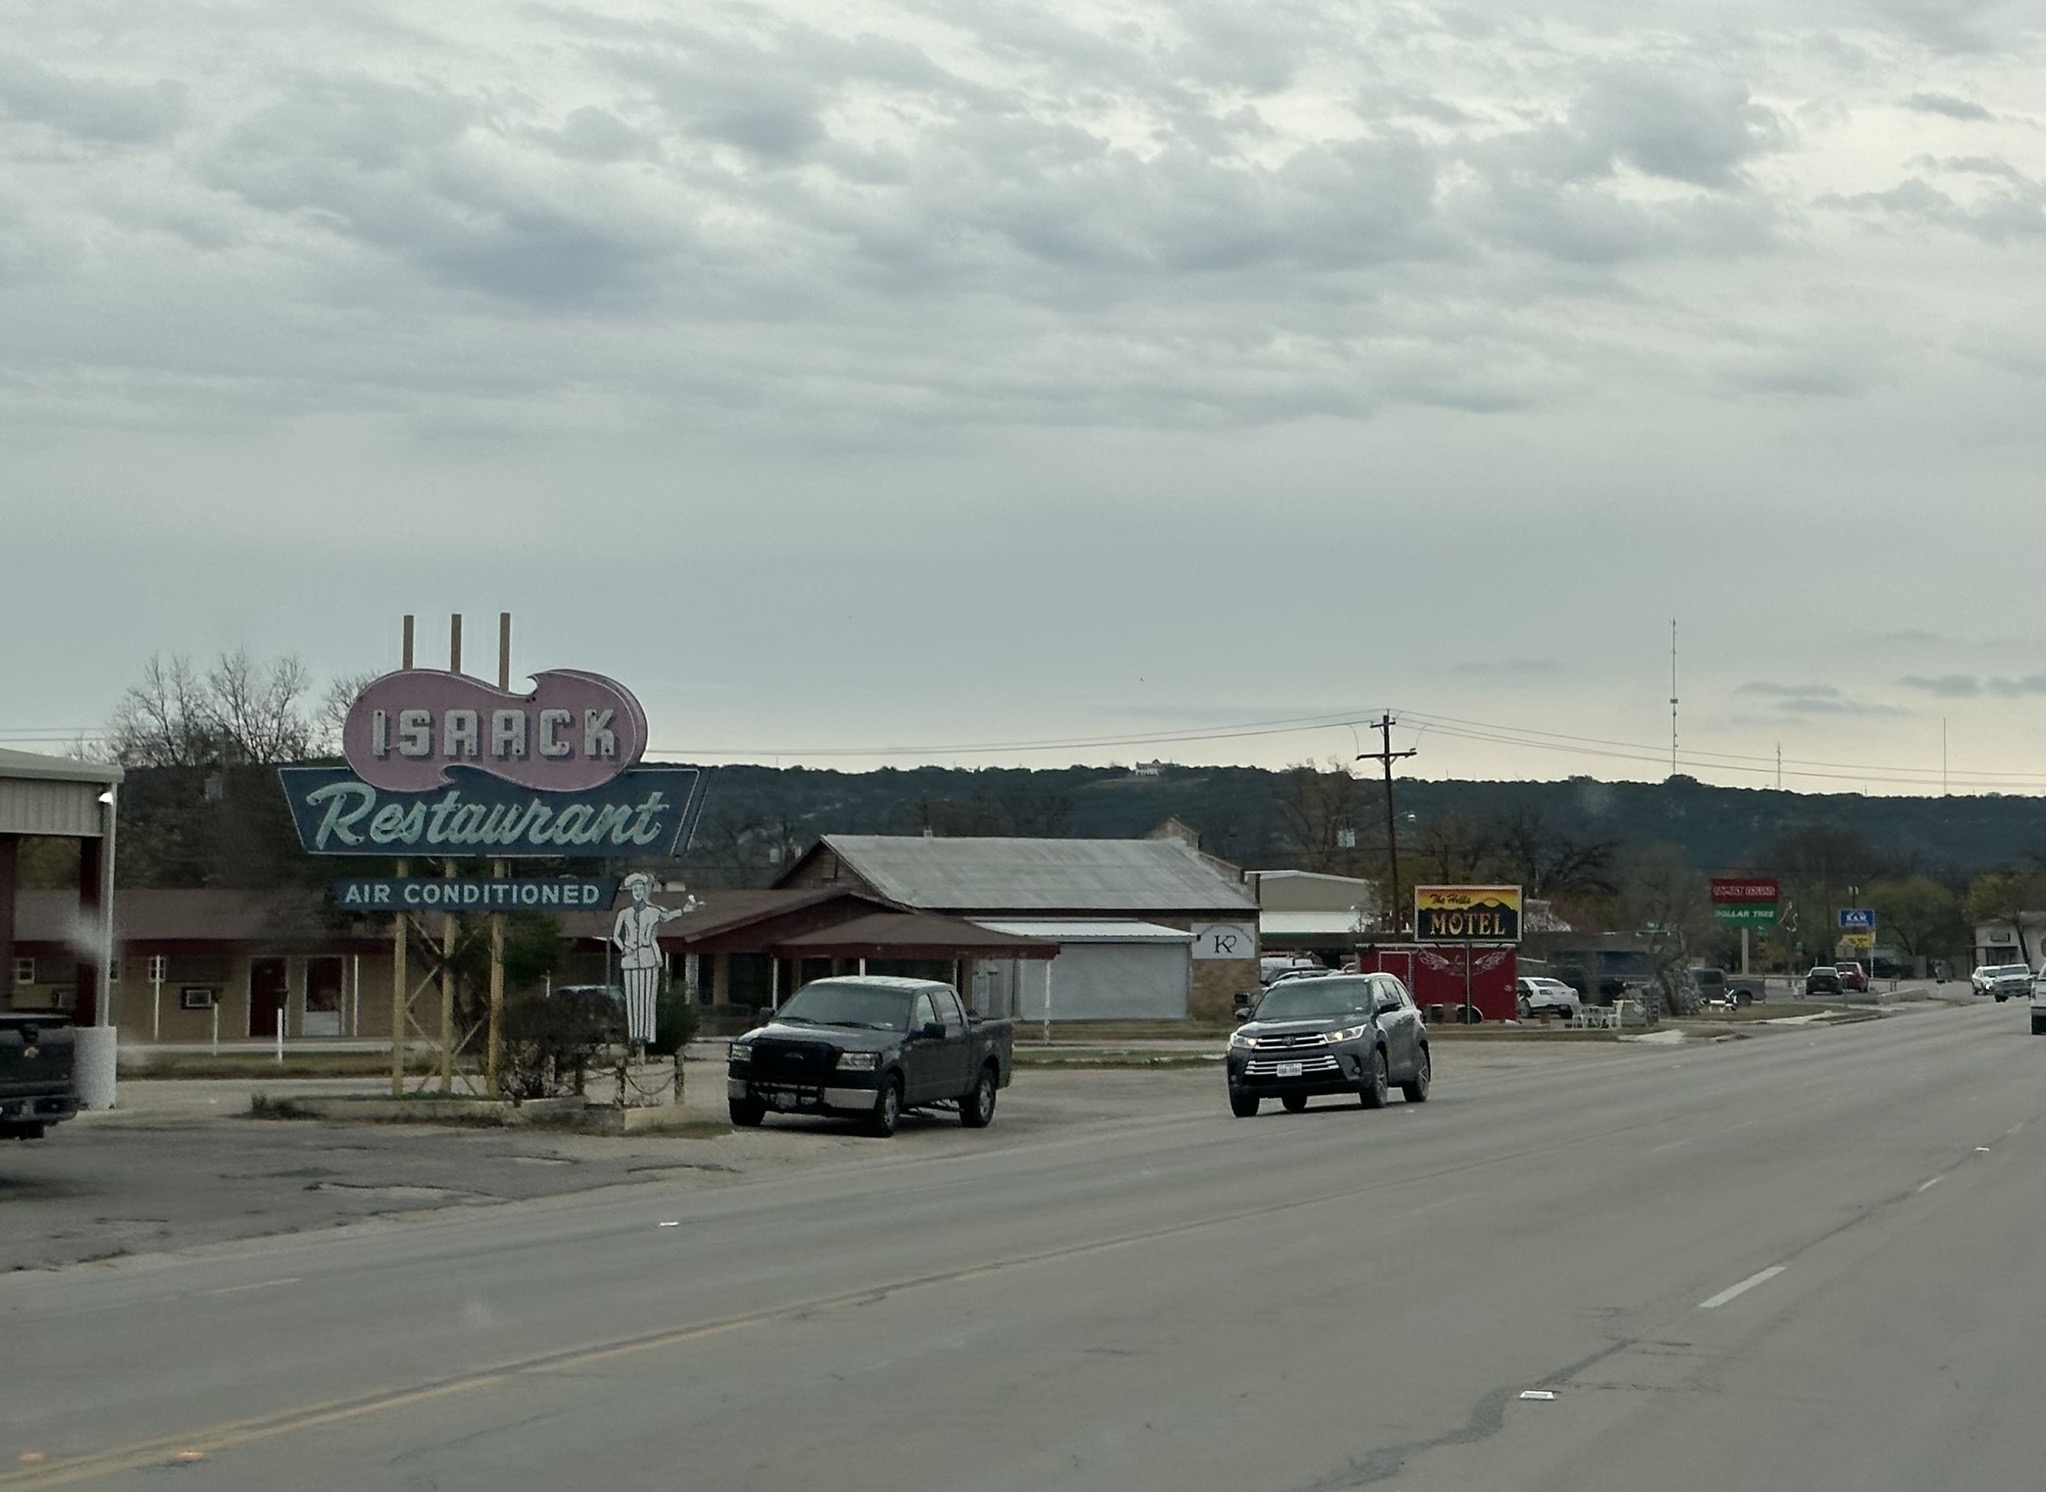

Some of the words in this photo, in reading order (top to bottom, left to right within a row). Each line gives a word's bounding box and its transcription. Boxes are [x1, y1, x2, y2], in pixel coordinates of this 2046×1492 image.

[371, 708, 616, 758] ISAACK
[306, 781, 670, 850] Restaurant
[345, 883, 391, 904] AIR
[403, 883, 600, 904] CONDITIONED
[1430, 912, 1506, 935] MOTEL
